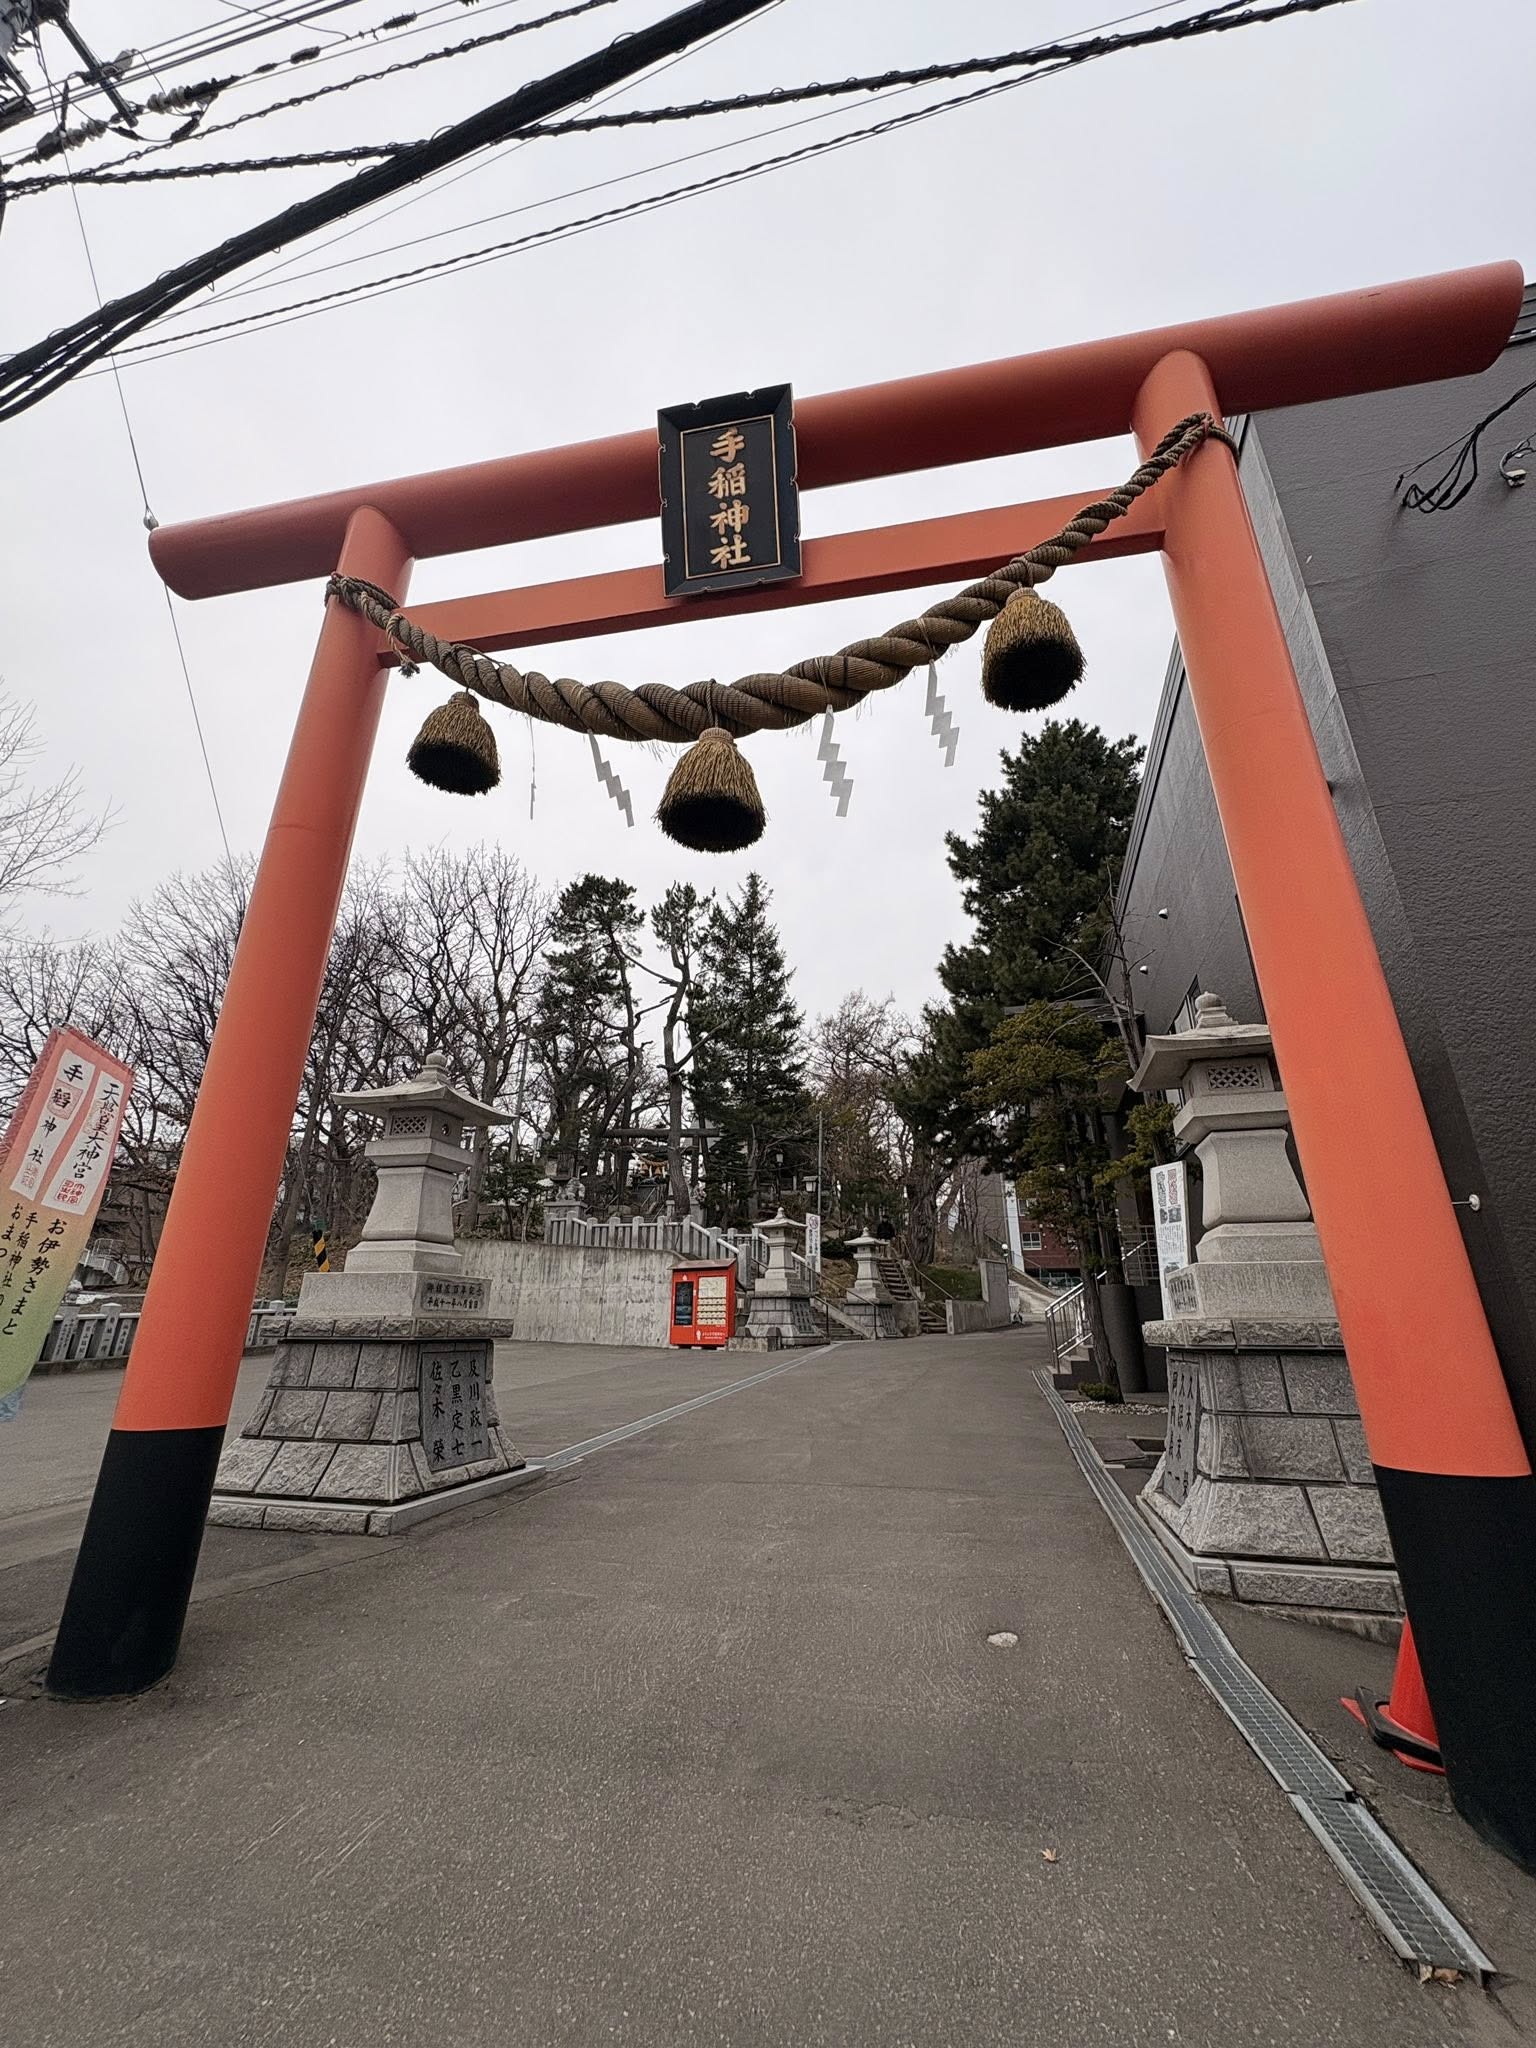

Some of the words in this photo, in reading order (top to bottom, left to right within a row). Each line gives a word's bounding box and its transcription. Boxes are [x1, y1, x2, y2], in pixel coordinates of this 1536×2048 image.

[708, 427, 751, 569] 手稲神社
[28, 1064, 84, 1165] 手稲神社
[72, 1083, 120, 1178] 天照皇大神宮
[2, 1218, 67, 1335] お伊勢さまと
[450, 1359, 465, 1456] 乙黒定七
[468, 1359, 483, 1445] 及川政一
